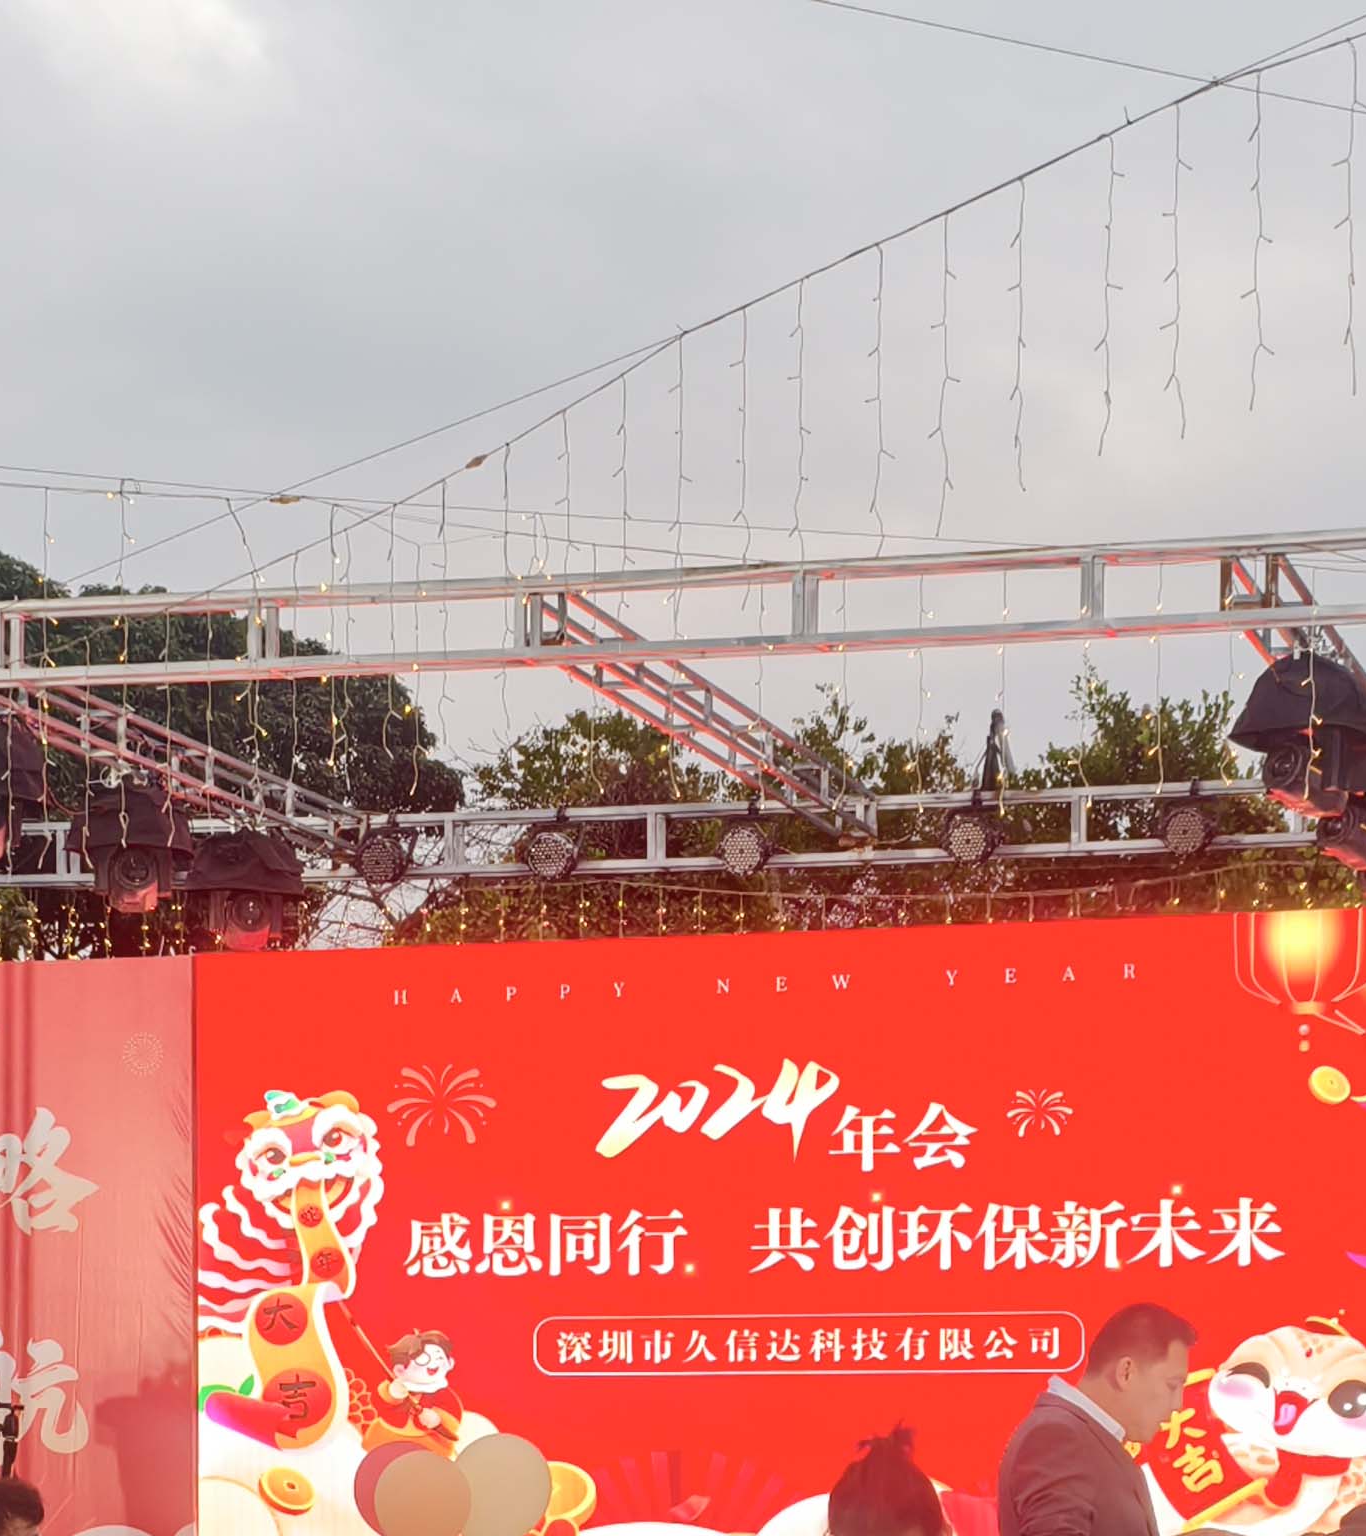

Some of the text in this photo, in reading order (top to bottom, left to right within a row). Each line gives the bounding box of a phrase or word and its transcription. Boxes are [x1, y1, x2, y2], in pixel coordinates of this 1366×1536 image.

[394, 963, 1135, 1006] HAPPY NEW YEAR
[403, 1197, 1286, 1278] 感恩同行 共创环保新未来
[556, 1326, 1062, 1365] 深圳市久信达科技有限公司
[1160, 1407, 1224, 1493] 大吉
